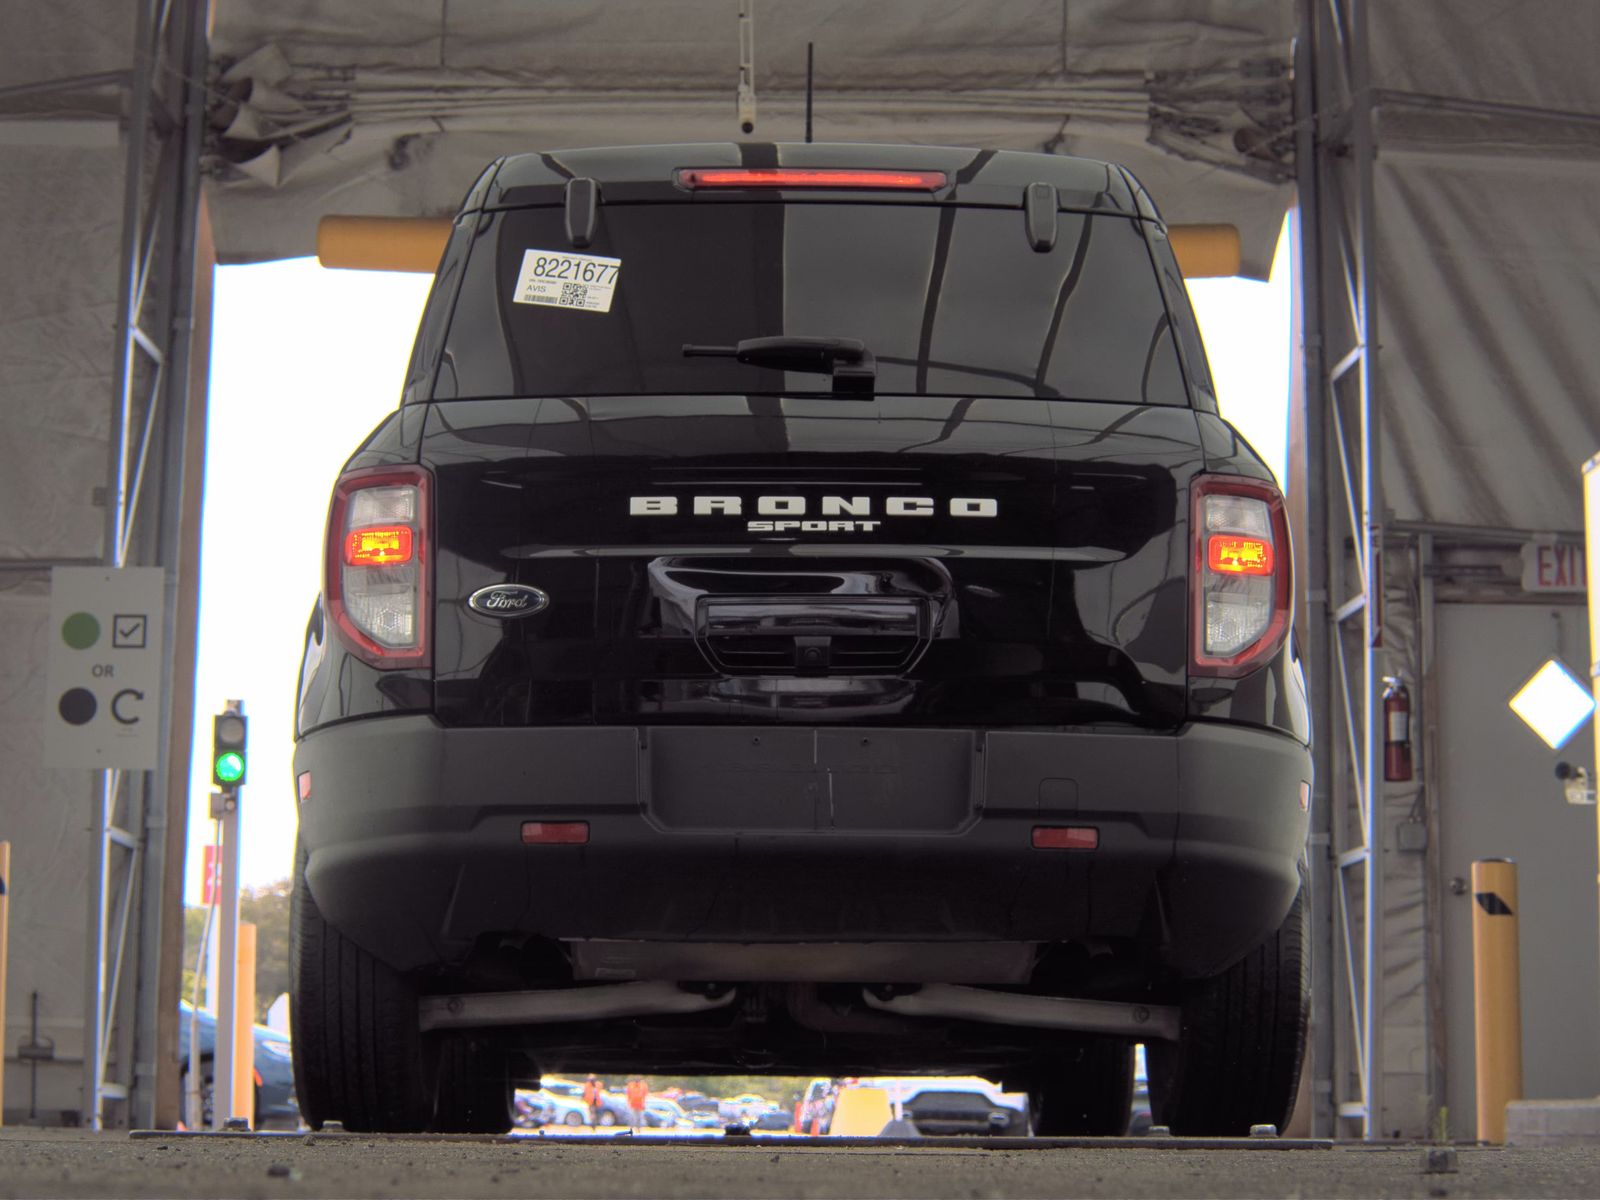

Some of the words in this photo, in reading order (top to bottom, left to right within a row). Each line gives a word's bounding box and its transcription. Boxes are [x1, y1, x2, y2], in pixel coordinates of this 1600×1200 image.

[533, 257, 620, 284] 8221677
[526, 284, 547, 293] AVIS
[630, 496, 998, 517] BRONCO
[747, 520, 881, 532] SPORT
[486, 591, 529, 609] Ford
[91, 664, 114, 678] OR
